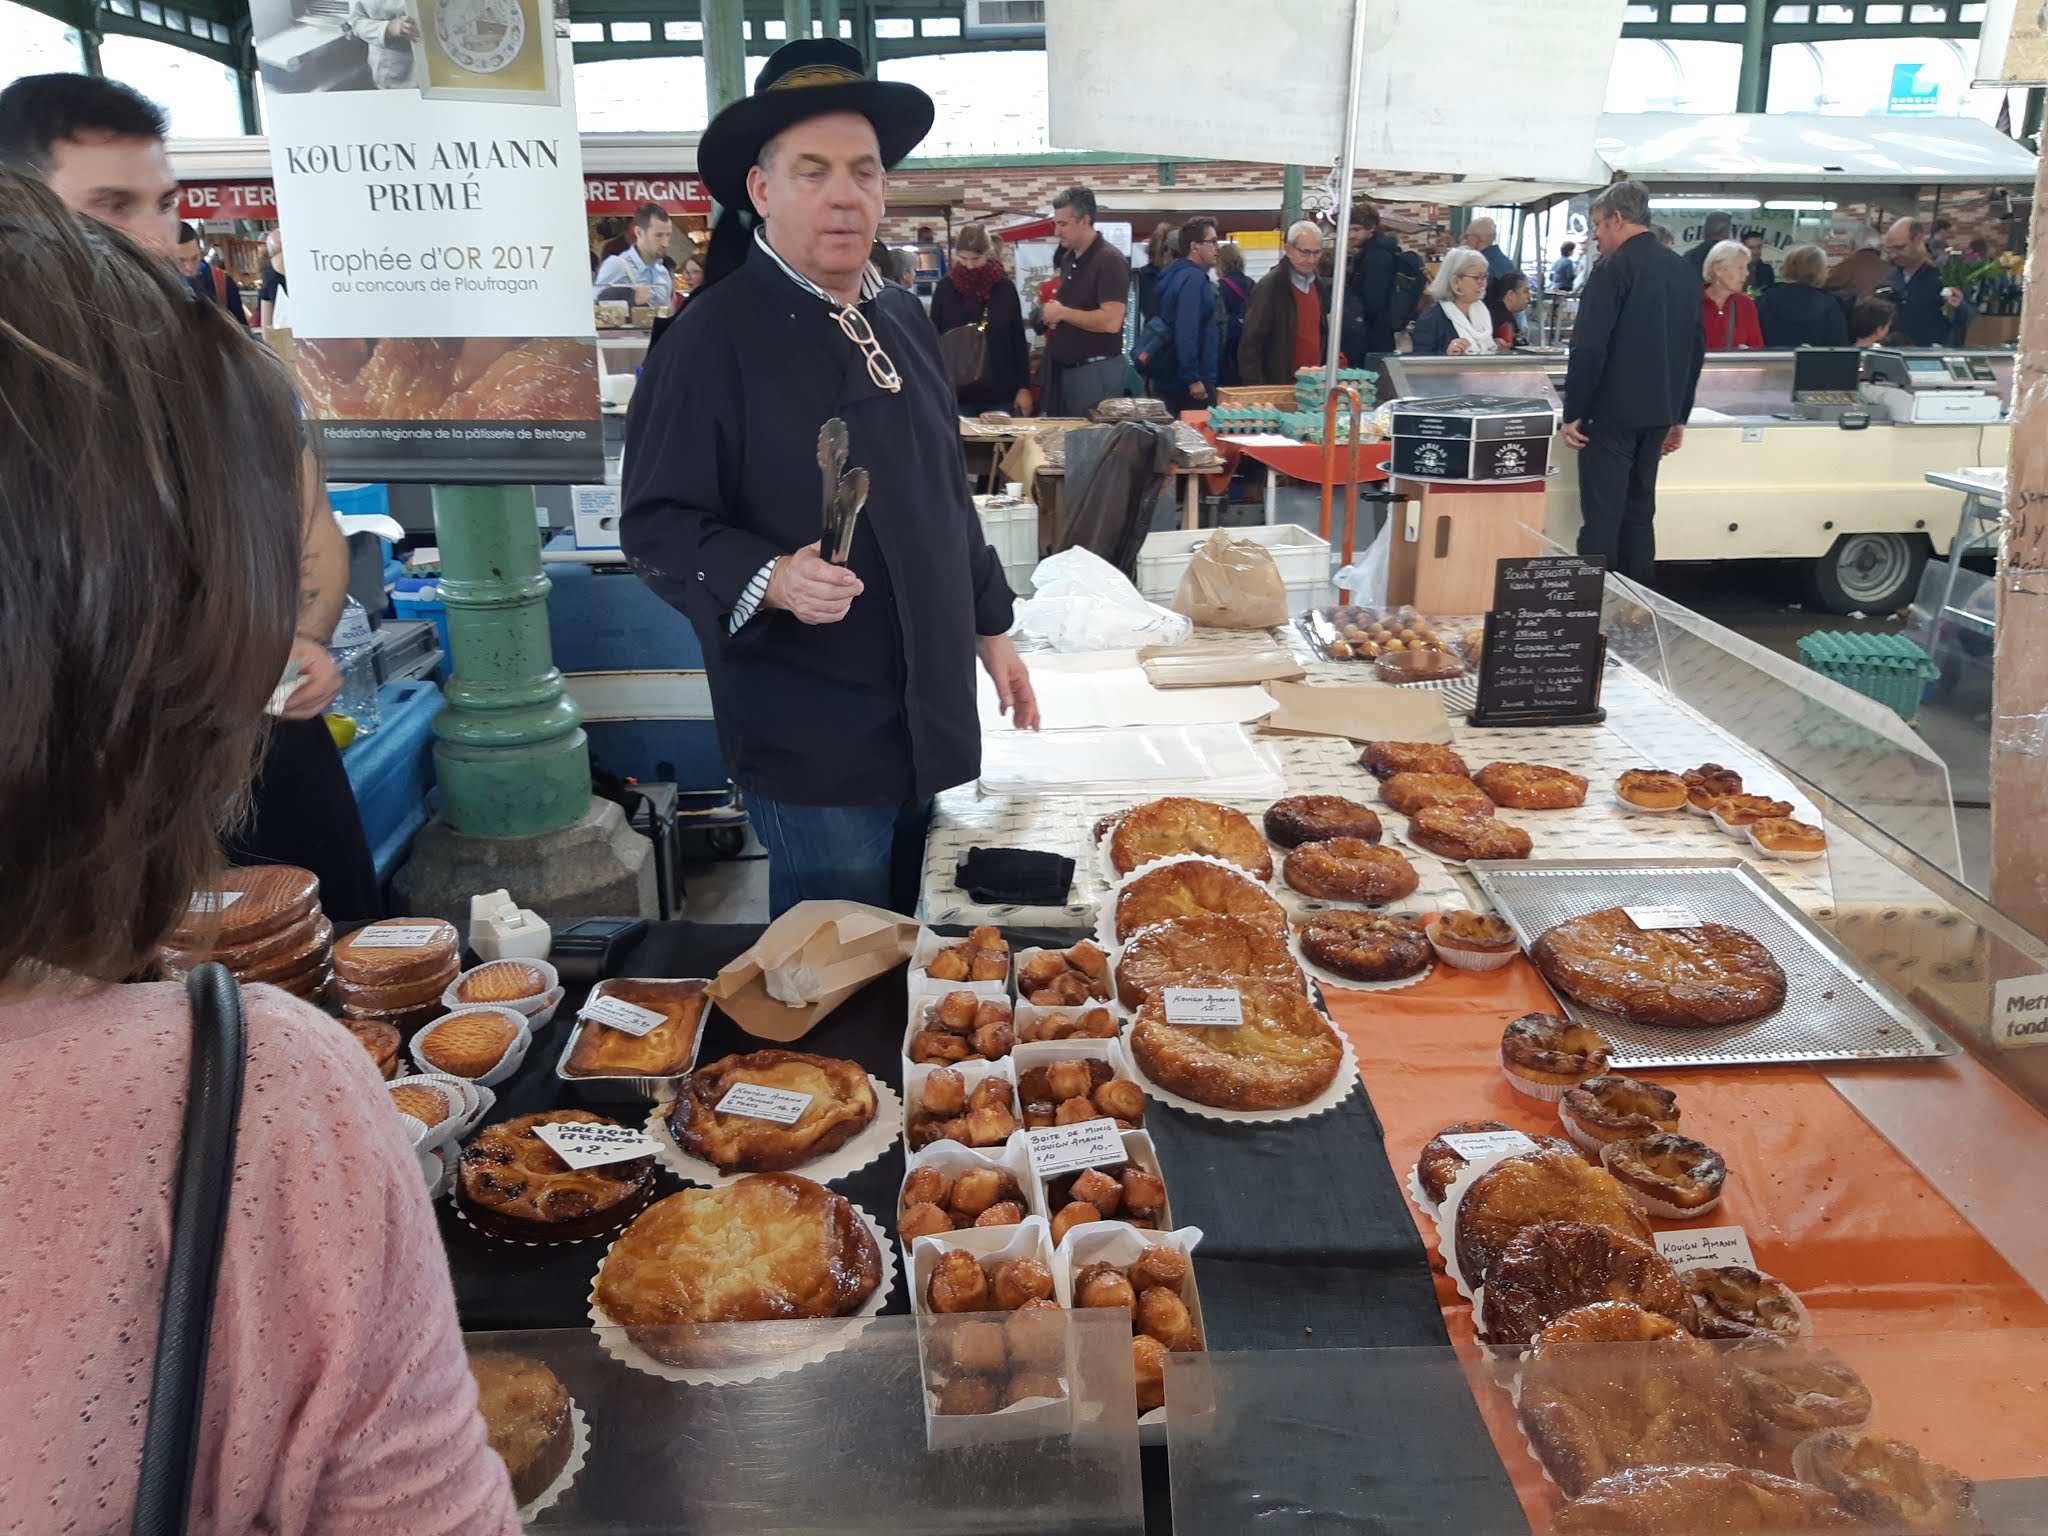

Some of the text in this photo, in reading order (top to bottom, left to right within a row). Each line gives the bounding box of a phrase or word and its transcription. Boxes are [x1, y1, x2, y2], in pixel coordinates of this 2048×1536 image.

[284, 140, 560, 174] KOUIGN AMANN
[187, 186, 221, 208] DE
[366, 172, 482, 212] PRIMÉ
[310, 246, 554, 276] Trophée d'OR 2017
[331, 276, 538, 294] au concours de Ploufragan
[324, 428, 586, 442] Fédération régionale de la pâtisserie de Bretagne
[1206, 995, 1235, 1004] AMANN
[770, 1093, 802, 1102] AMANN
[558, 1126, 635, 1137] BRETON
[1085, 1123, 1112, 1133] MINIS
[560, 1133, 648, 1144] ABRICOT
[1034, 1134, 1104, 1152] KOUIGN AMANN
[1663, 1237, 1737, 1255] KOUIGN AMANN
